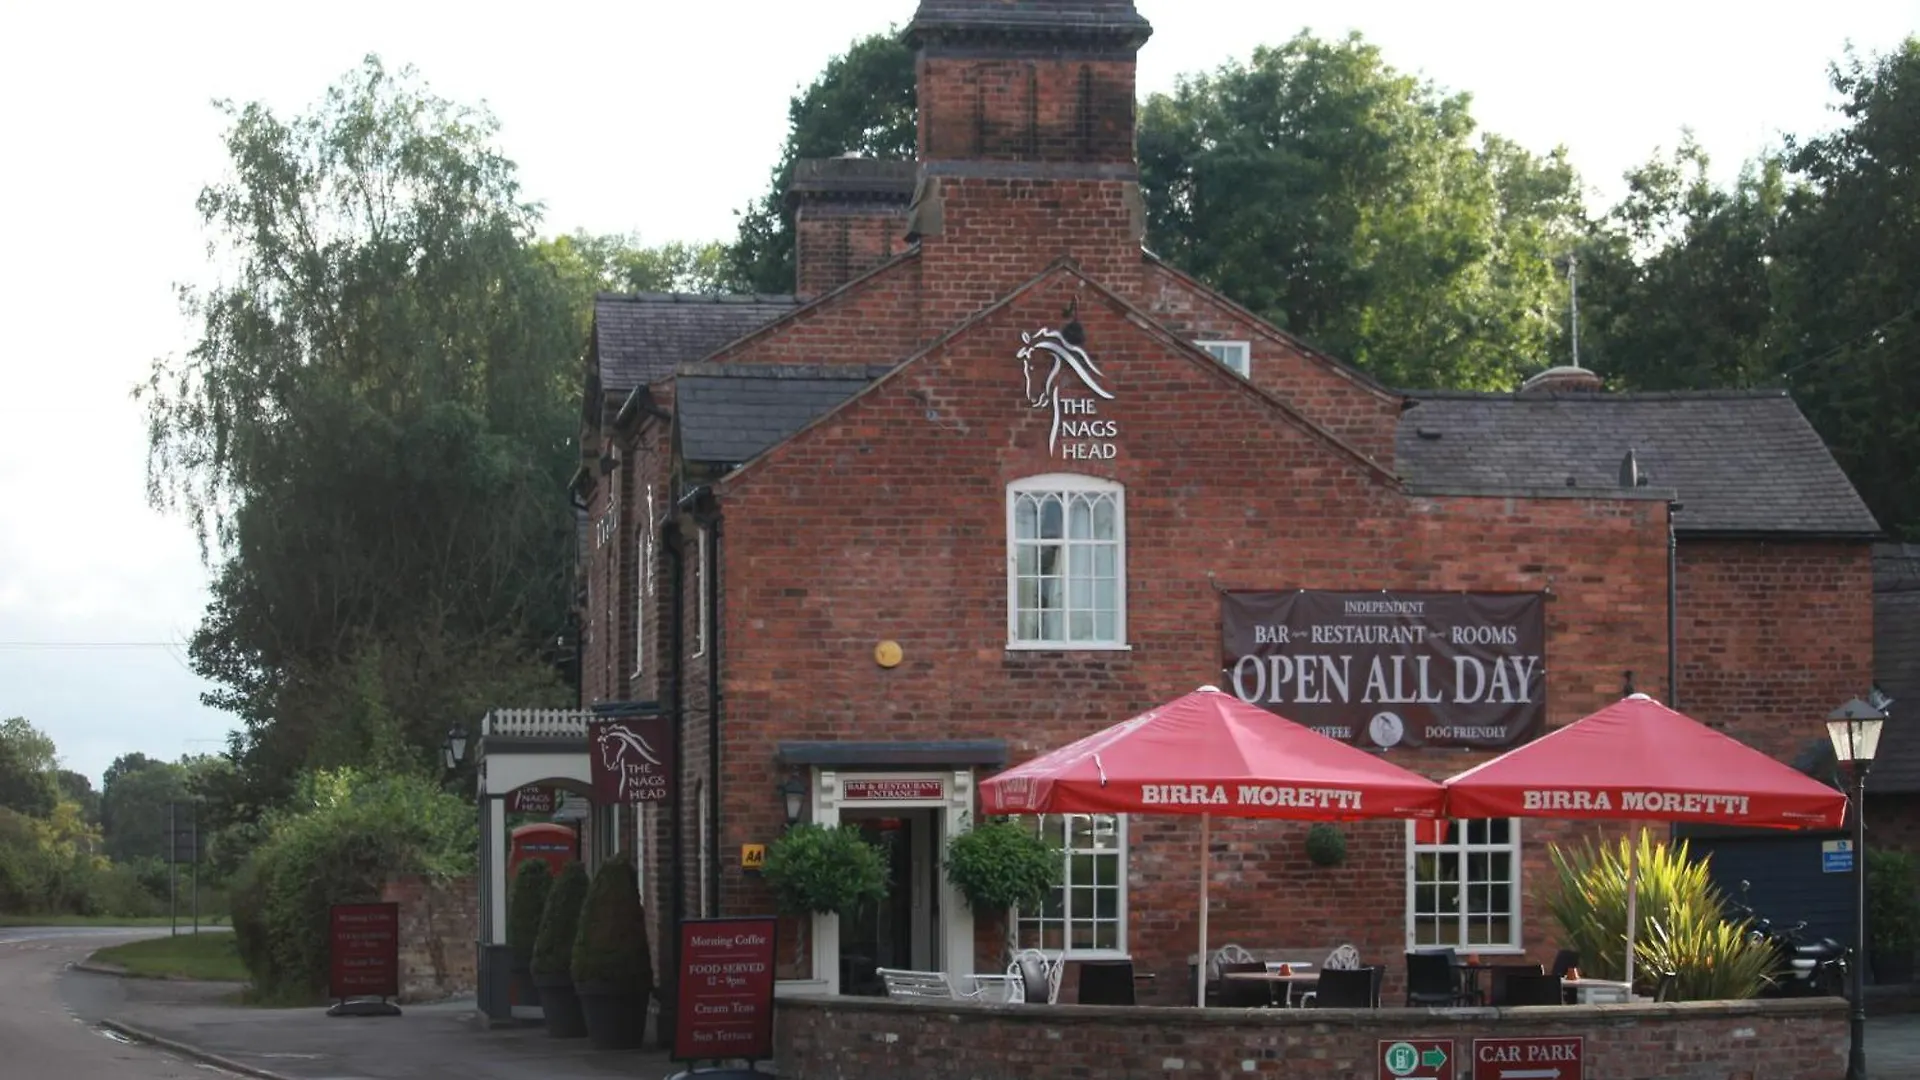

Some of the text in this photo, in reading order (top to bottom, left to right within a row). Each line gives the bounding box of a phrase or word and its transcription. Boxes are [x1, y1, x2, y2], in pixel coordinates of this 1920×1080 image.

[1061, 399, 1097, 414] THE
[1062, 421, 1117, 437] NAGS
[1063, 443, 1117, 459] HEAD
[1344, 601, 1424, 613] INDEPENDENT
[1255, 625, 1517, 644] BAR RESTAURANT ROOMS
[1233, 655, 1538, 703] OPEN ALL DAY
[1425, 726, 1507, 738] DOG FRIENDLY
[628, 764, 652, 774] THE
[629, 777, 666, 787] NAGS
[848, 782, 866, 790] BAR
[877, 782, 939, 790] RESTAURANT
[629, 789, 666, 800] HEAD
[867, 790, 920, 798] ENTRANCE
[1141, 784, 1362, 809] BIRRA MORETTI
[1523, 790, 1749, 815] BIRRA MORETTI
[690, 934, 766, 949] Morning Coffee
[689, 962, 765, 975] FOOD SERVED
[694, 1003, 728, 1014] Cream
[1479, 1044, 1577, 1062] CAR PARK
